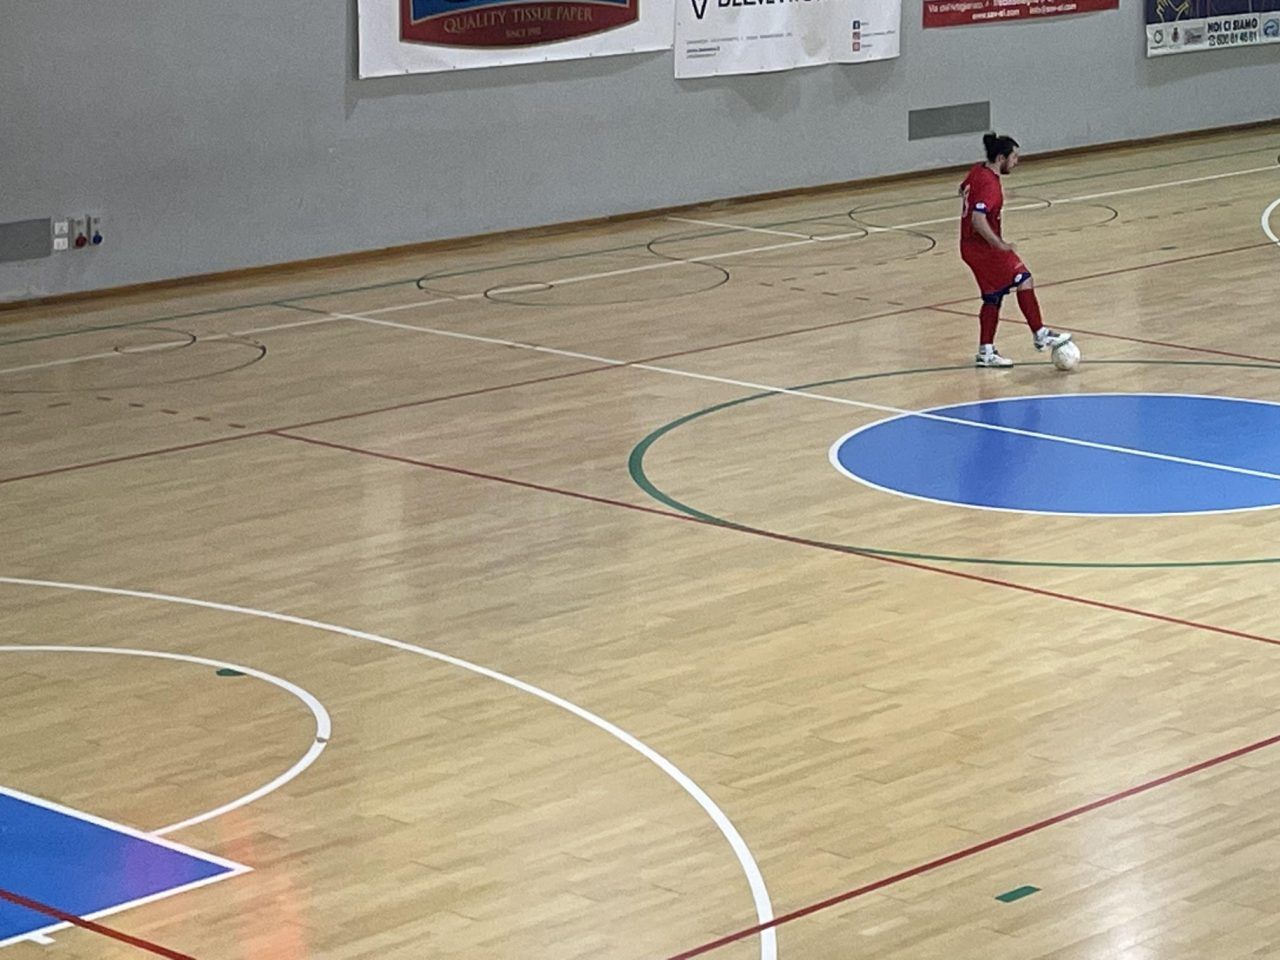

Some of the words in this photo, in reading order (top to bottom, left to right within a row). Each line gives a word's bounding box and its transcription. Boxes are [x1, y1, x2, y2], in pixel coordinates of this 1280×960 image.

[443, 10, 507, 33] QUALITY
[513, 7, 556, 23] TISSUE
[557, 5, 593, 21] PAPER
